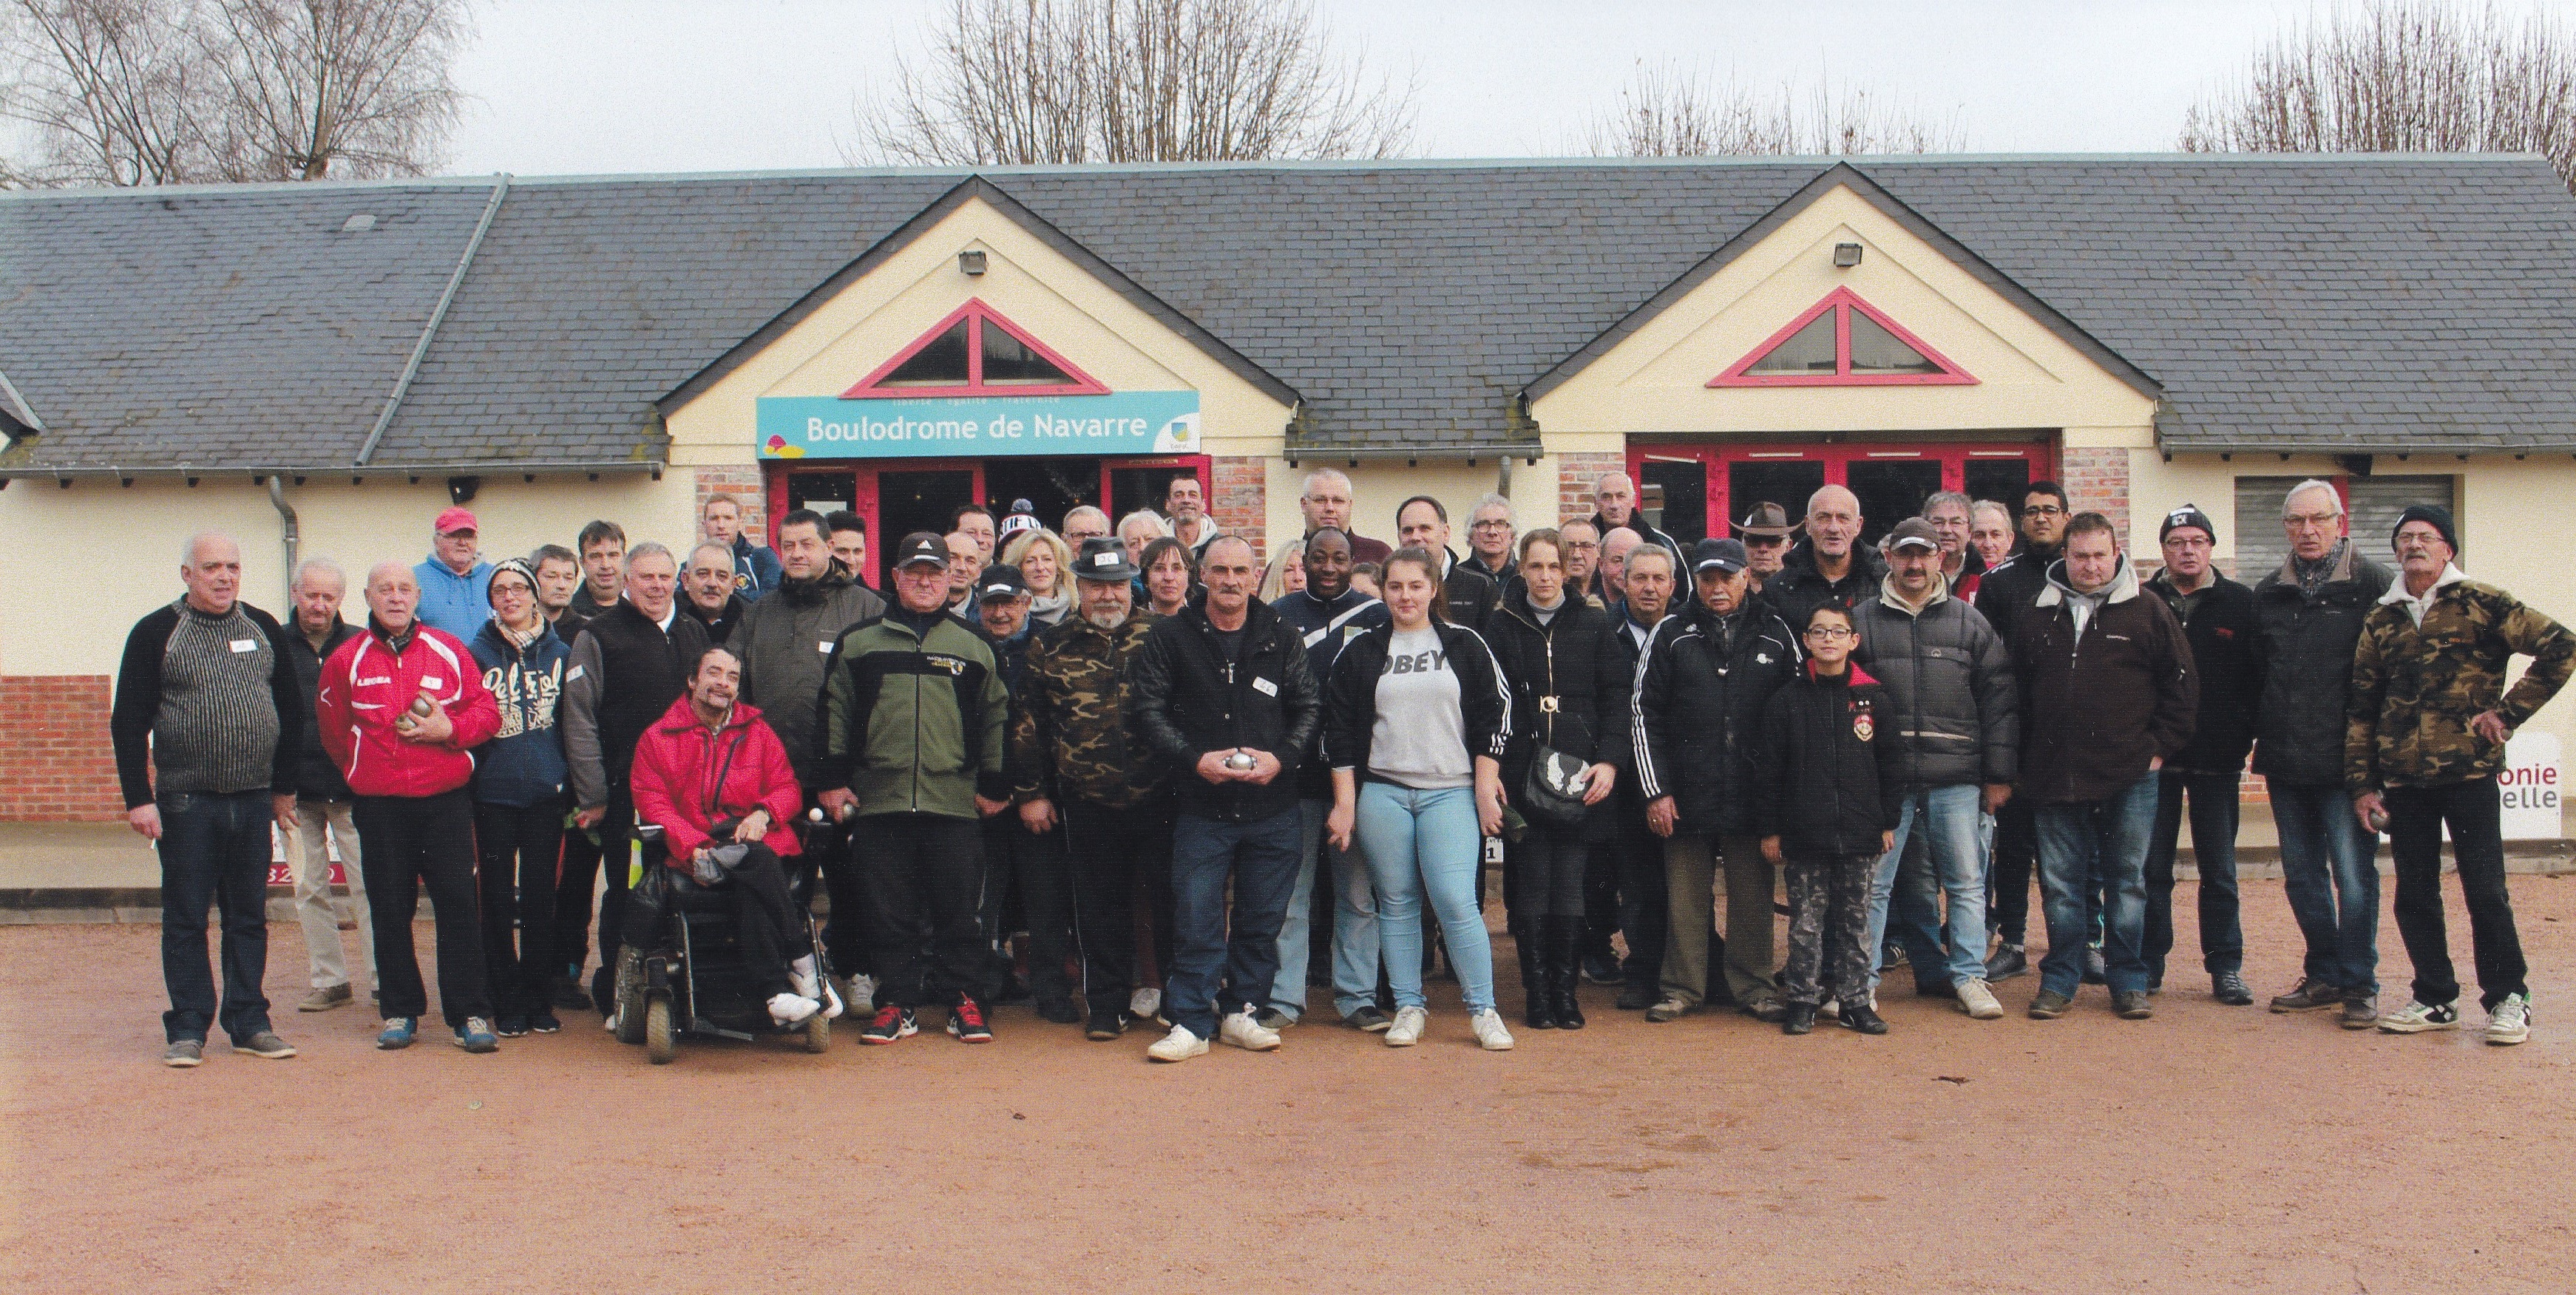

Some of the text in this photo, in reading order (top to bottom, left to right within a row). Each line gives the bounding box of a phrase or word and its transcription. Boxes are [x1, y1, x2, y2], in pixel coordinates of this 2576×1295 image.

[807, 413, 1147, 442] Boulodrome de Navarre
[2502, 787, 2557, 809] elle
